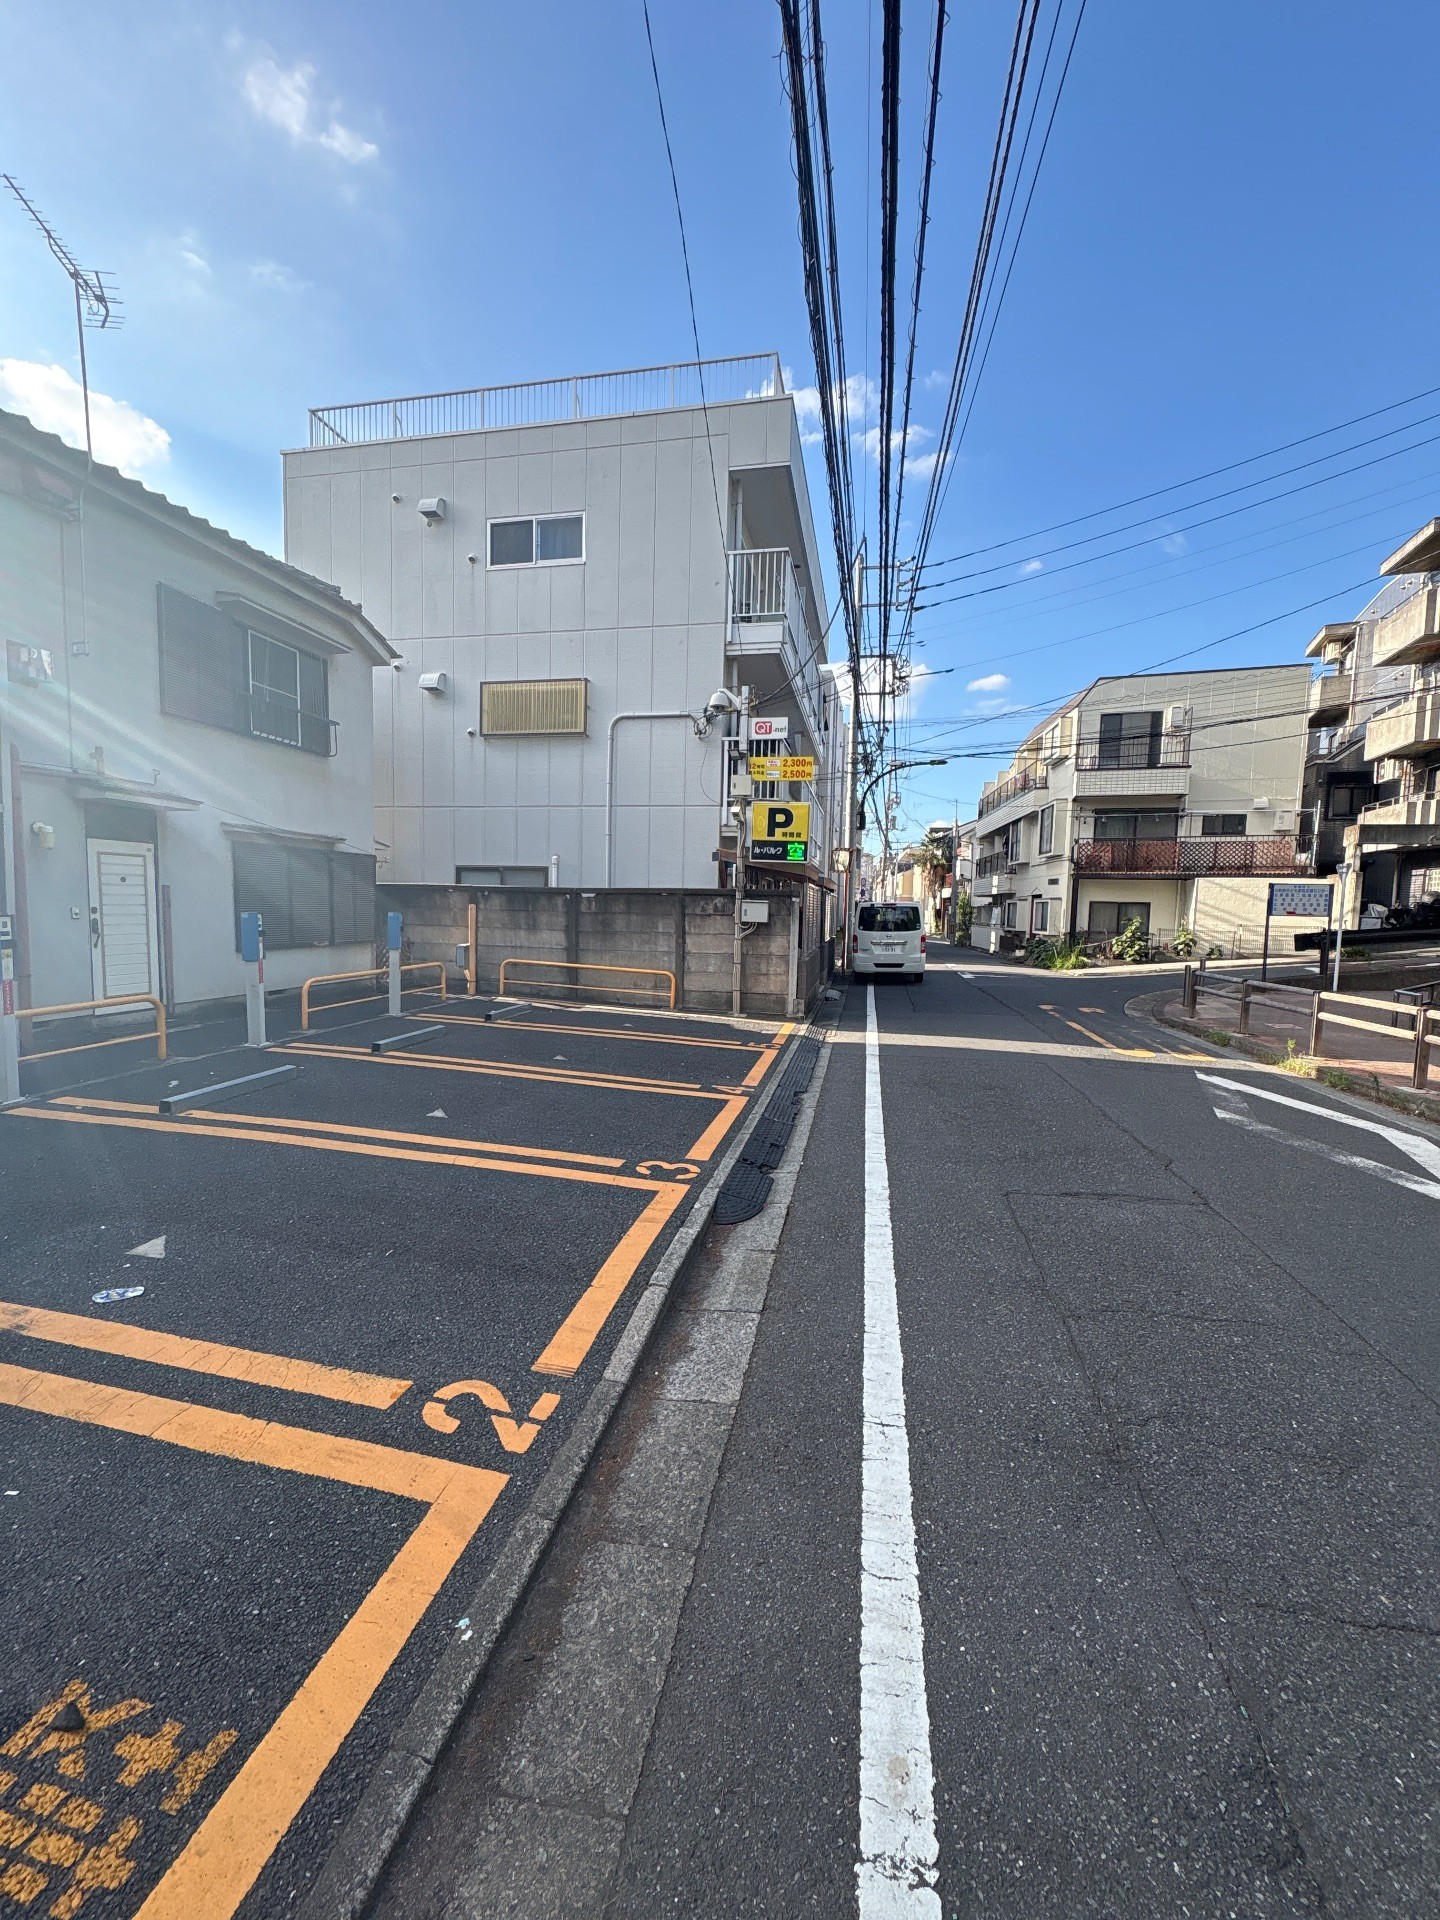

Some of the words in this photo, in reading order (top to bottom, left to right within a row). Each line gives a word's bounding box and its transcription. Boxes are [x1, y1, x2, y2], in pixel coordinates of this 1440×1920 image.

[755, 721, 787, 735] QT-net
[782, 759, 812, 768] 2,300円
[782, 770, 812, 779] 2,500円
[767, 808, 794, 837] P
[787, 843, 805, 861] 空
[747, 1041, 782, 1049] 5
[712, 1084, 755, 1094] 4
[635, 1160, 702, 1180] 3
[421, 1379, 561, 1455] 2
